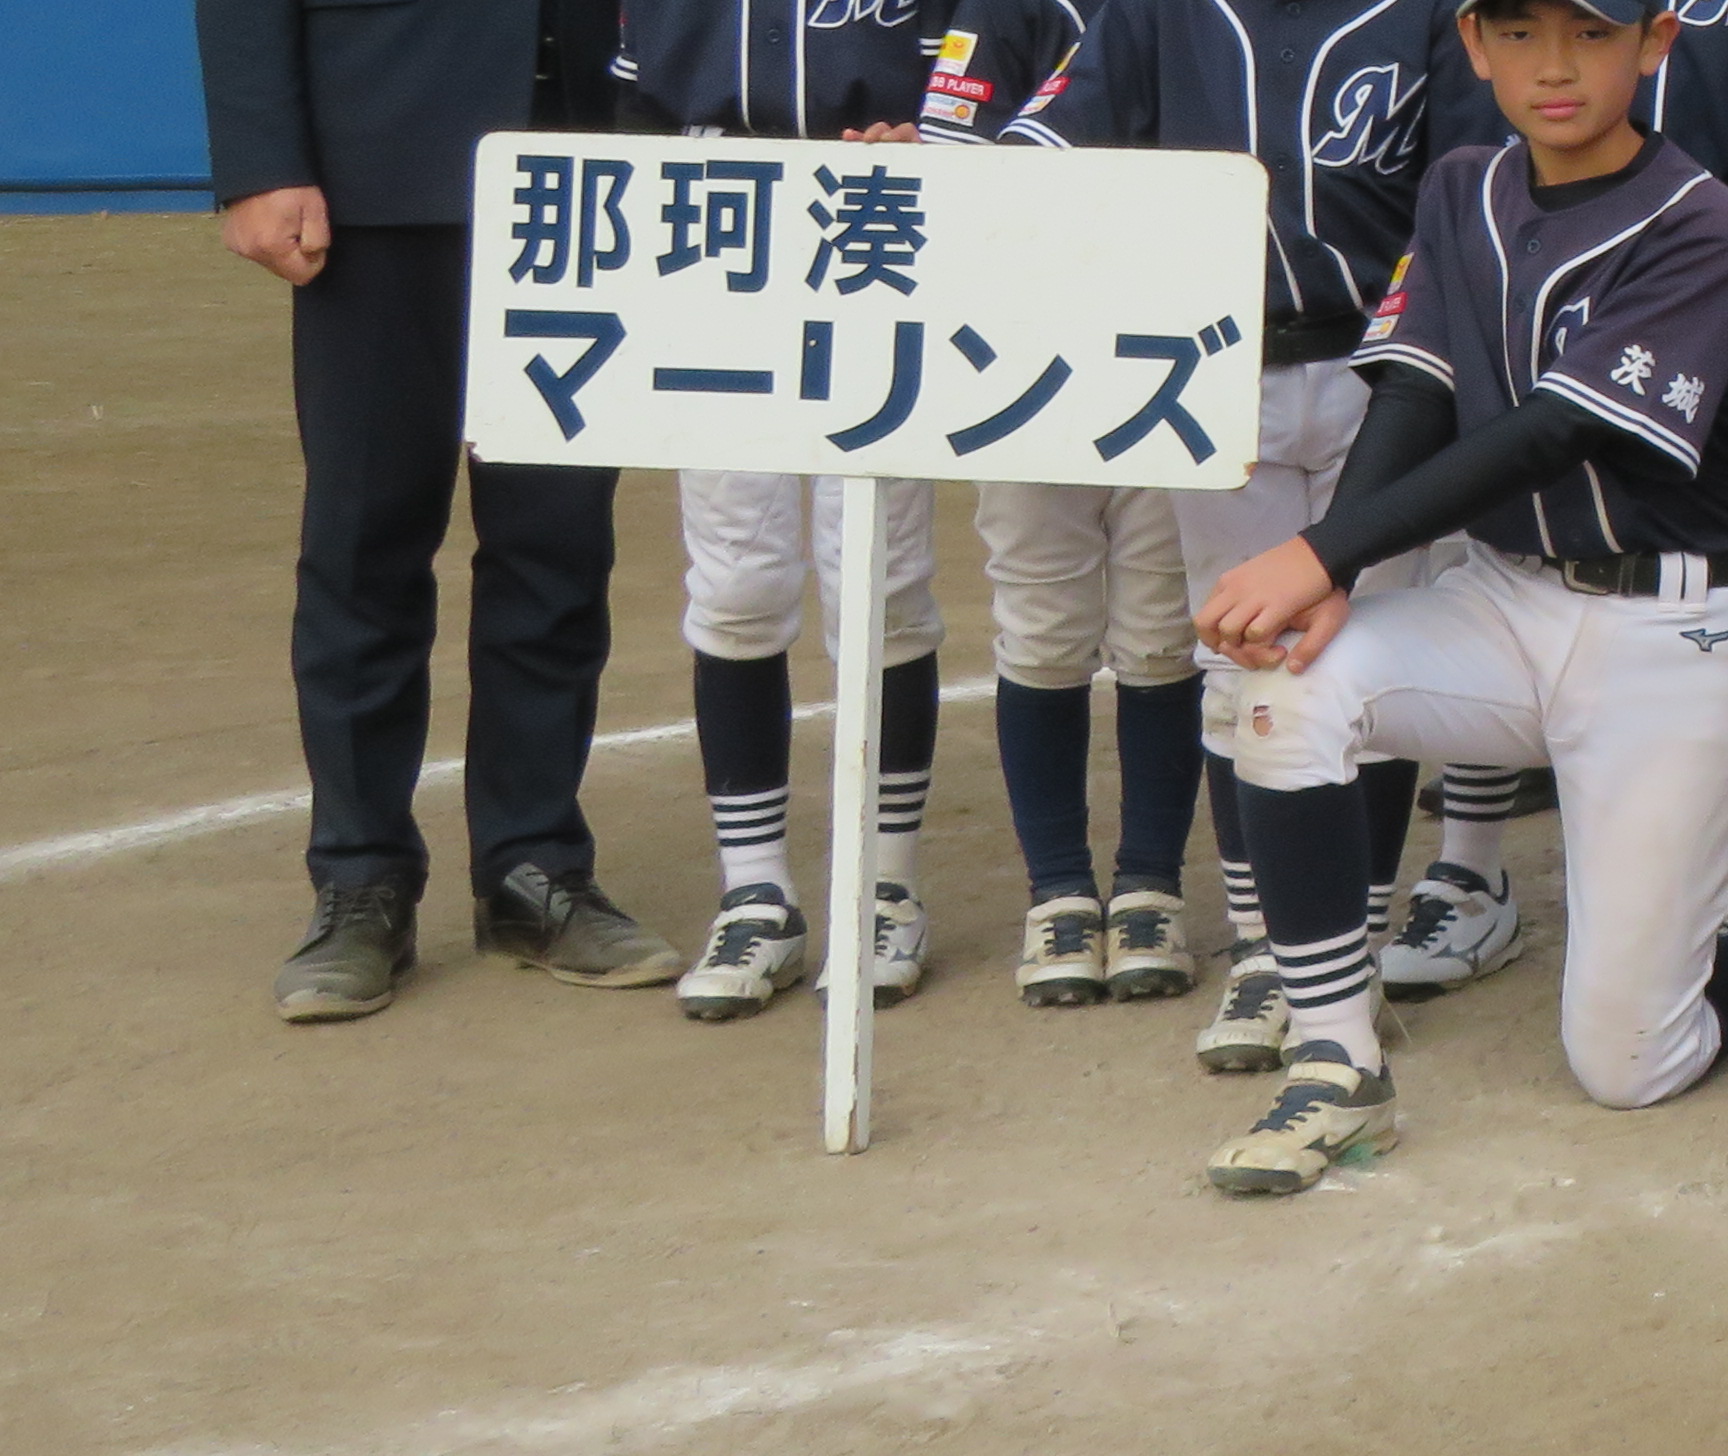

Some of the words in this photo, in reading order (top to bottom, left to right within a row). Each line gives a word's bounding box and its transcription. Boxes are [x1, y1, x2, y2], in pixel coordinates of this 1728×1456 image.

[946, 78, 985, 96] PLAYER
[508, 154, 928, 297] 那珂湊
[504, 309, 1243, 465] マーリンズ
[1610, 344, 1705, 424] 茨城
